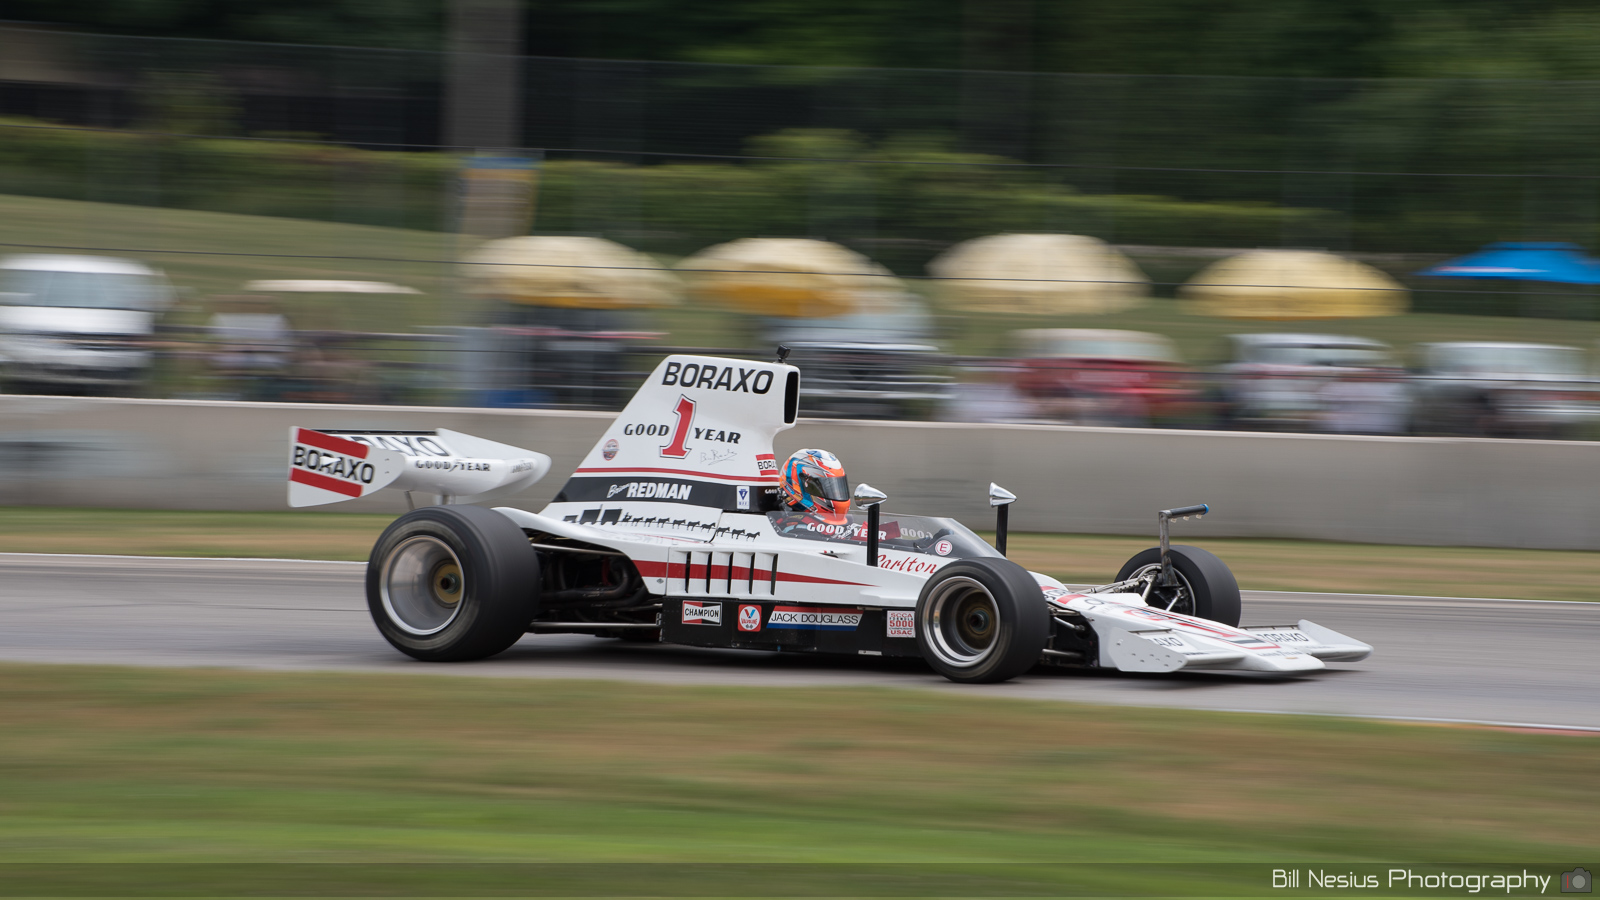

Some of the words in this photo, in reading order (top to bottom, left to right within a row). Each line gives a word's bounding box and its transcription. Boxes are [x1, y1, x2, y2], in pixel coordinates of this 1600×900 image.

[662, 362, 773, 394] BORAXO
[624, 423, 669, 436] GOOD
[694, 427, 741, 444] YEAR
[660, 394, 696, 459] 1
[415, 460, 449, 470] GOOD
[459, 461, 491, 472] YEAR
[626, 482, 692, 500] REDMAN
[806, 522, 844, 535] GOOD
[853, 528, 887, 540] YER
[684, 607, 719, 618] CHAMPION
[771, 612, 798, 623] JACK
[801, 613, 858, 625] DOUGLASS
[889, 620, 914, 628] 5000
